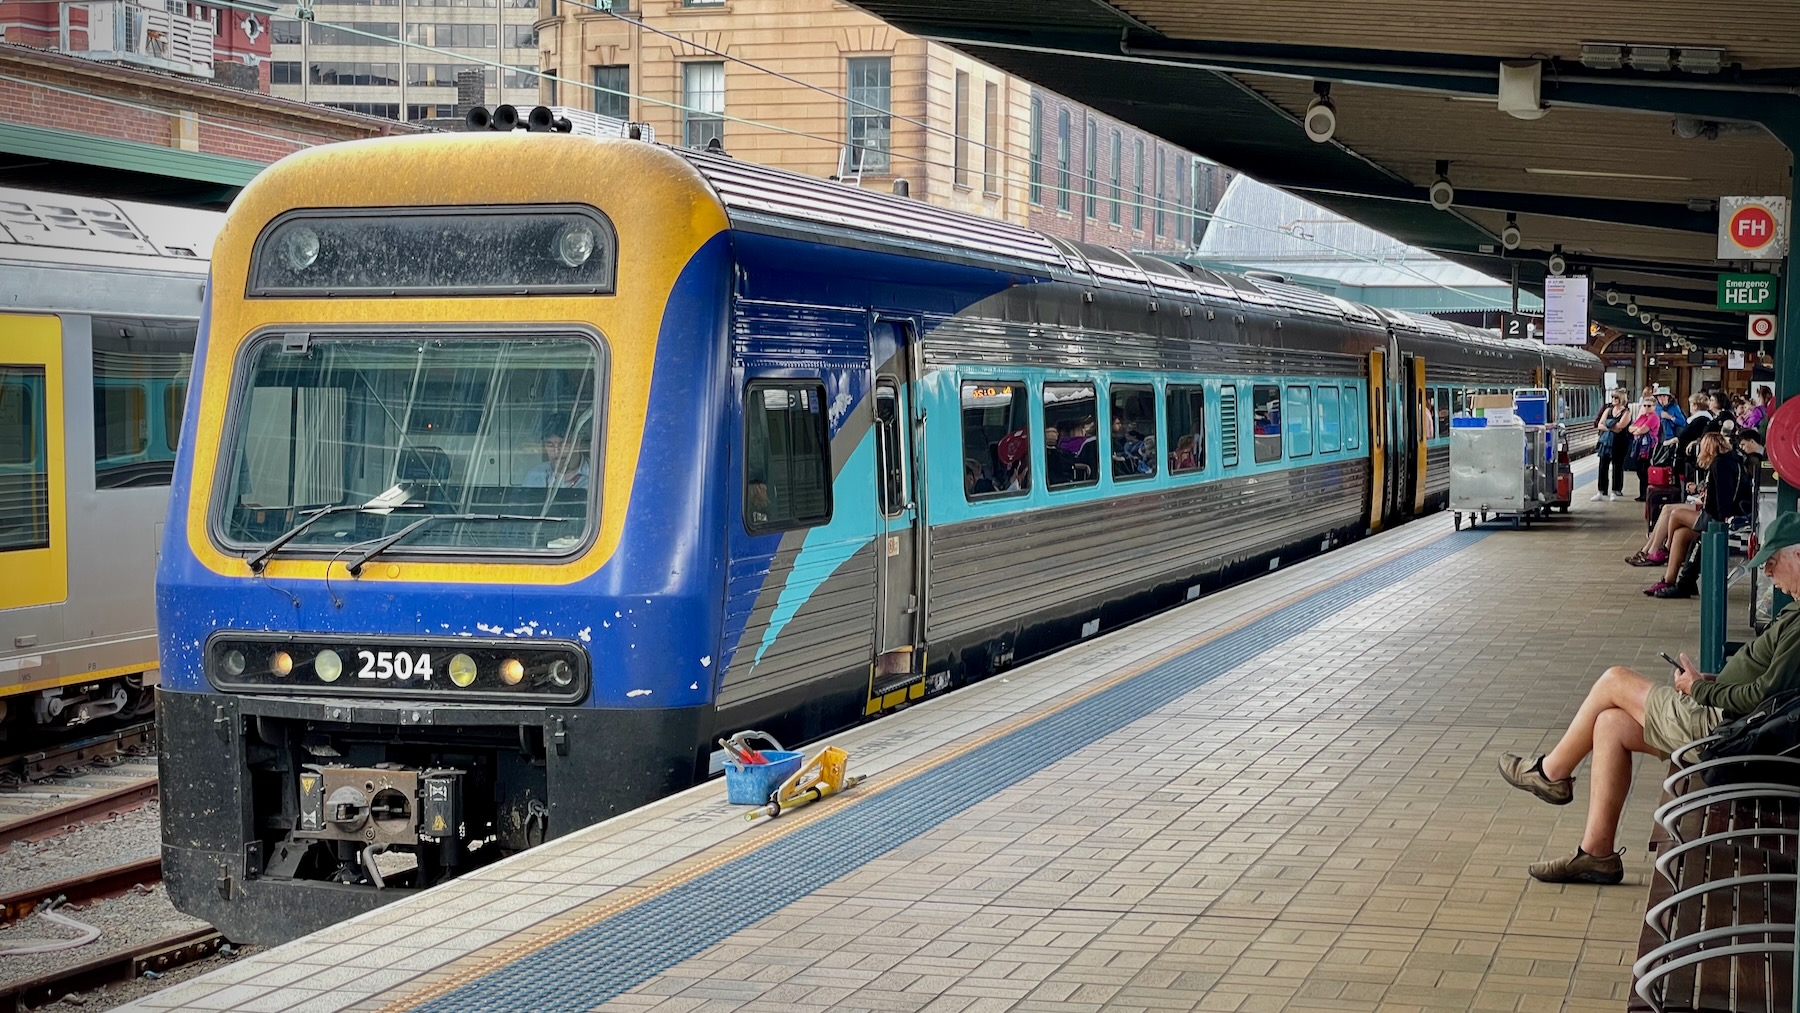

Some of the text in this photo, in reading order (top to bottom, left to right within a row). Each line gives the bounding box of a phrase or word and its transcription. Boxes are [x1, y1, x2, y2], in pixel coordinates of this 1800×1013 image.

[1738, 219, 1766, 237] FH
[1725, 280, 1769, 289] Emergency
[1725, 288, 1769, 304] HELP
[1509, 320, 1520, 335] 2
[1649, 357, 1656, 366] 2
[357, 650, 433, 681] 2504
